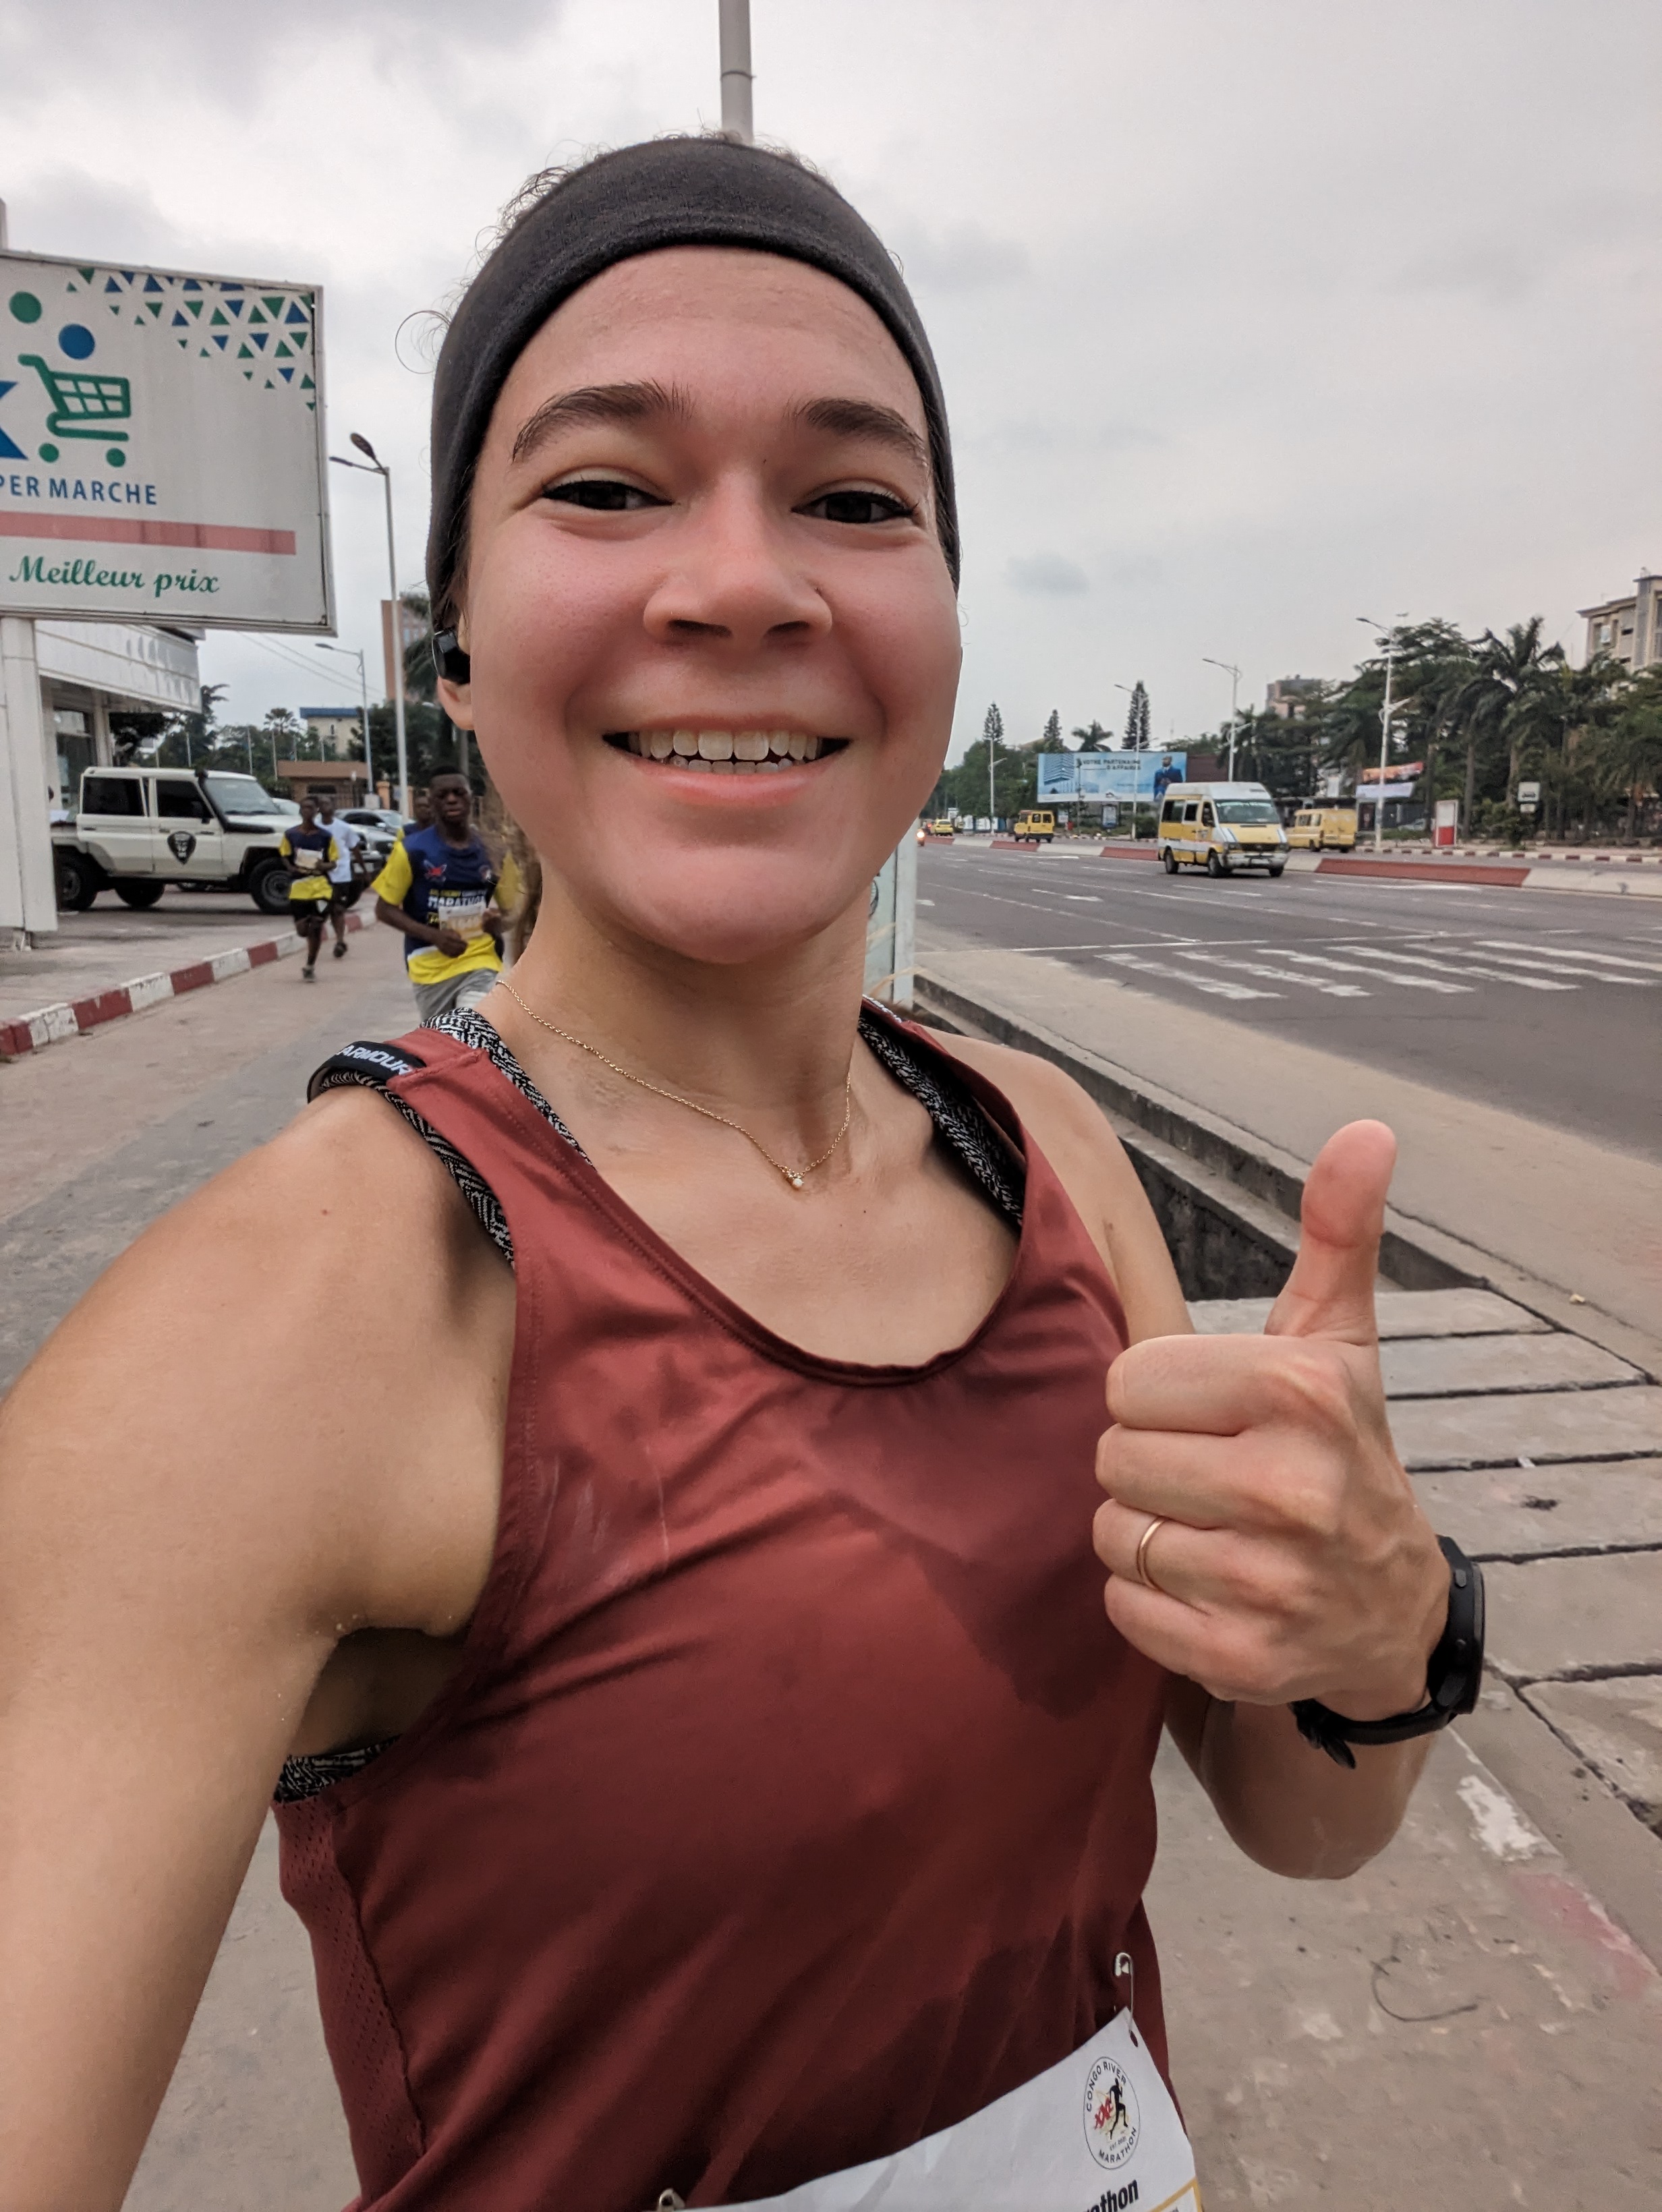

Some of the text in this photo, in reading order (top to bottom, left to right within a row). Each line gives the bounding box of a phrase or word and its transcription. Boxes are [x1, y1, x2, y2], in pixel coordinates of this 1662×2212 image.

[49, 477, 157, 505] MARCHE
[9, 555, 220, 598] Meilleur prix
[337, 1045, 413, 1075] ARMOUR
[1086, 2061, 1127, 2112] CONGO RIVER
[1099, 2126, 1137, 2163] MARATHON
[1083, 2179, 1139, 2212] thon
